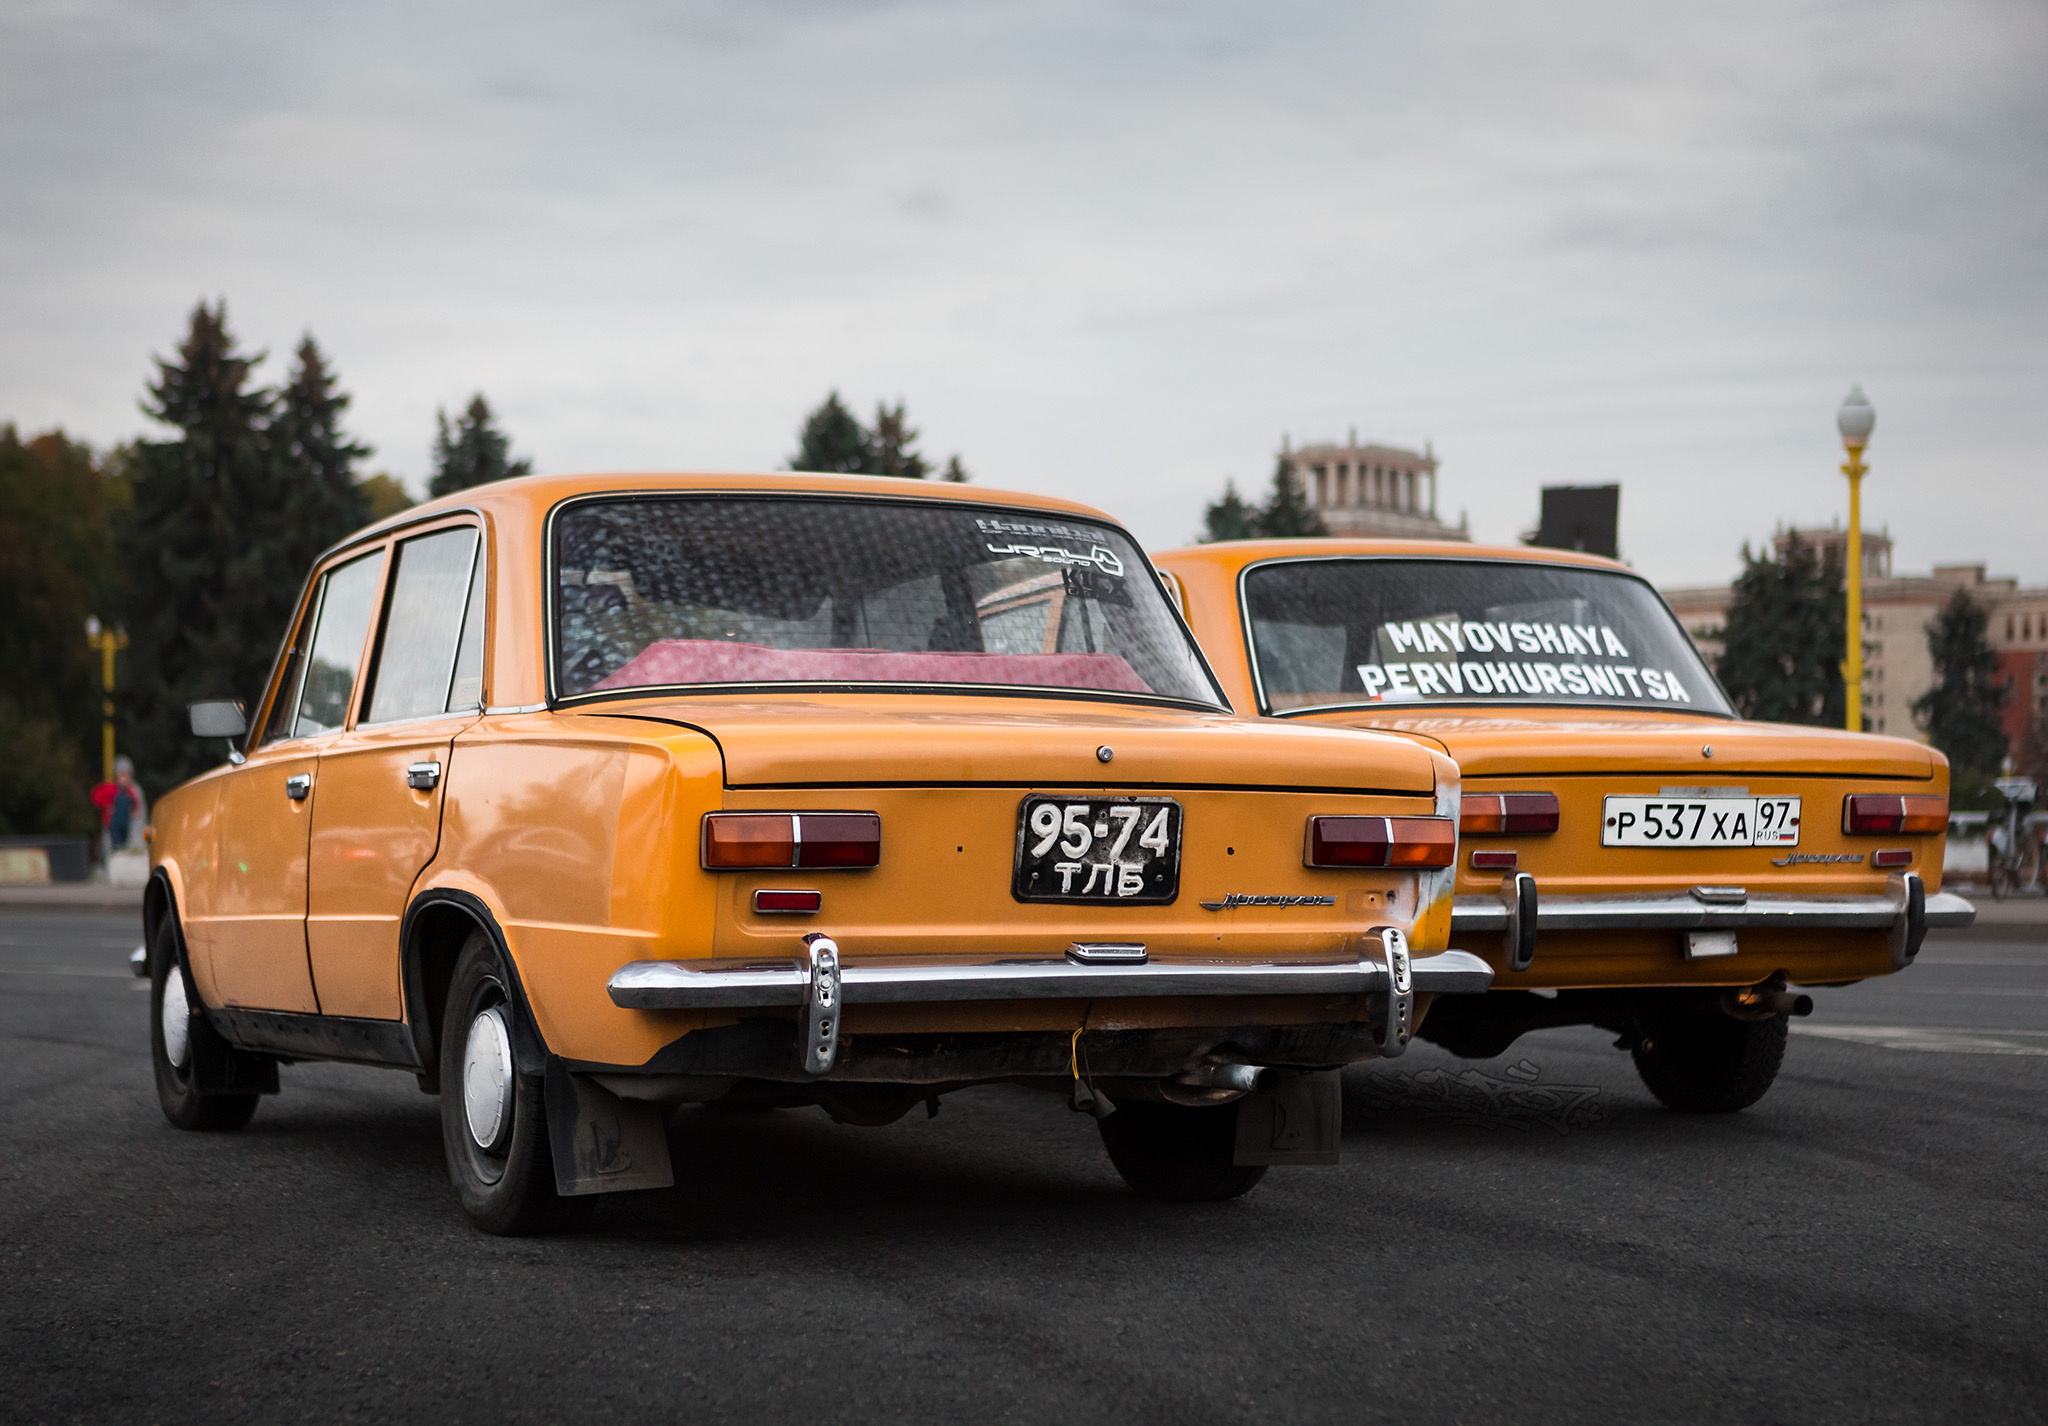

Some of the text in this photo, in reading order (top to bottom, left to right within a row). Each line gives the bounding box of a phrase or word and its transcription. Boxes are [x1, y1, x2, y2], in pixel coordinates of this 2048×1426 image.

[1043, 556, 1091, 567] SOUND
[1385, 621, 1629, 658] MAYOVSKAYA
[1357, 661, 1691, 703] PERVOKURSNITSA
[1030, 803, 1170, 859] 95-74
[1760, 802, 1790, 829] 97
[1756, 831, 1778, 841] RUS
[1054, 862, 1144, 897] ТЛБ
